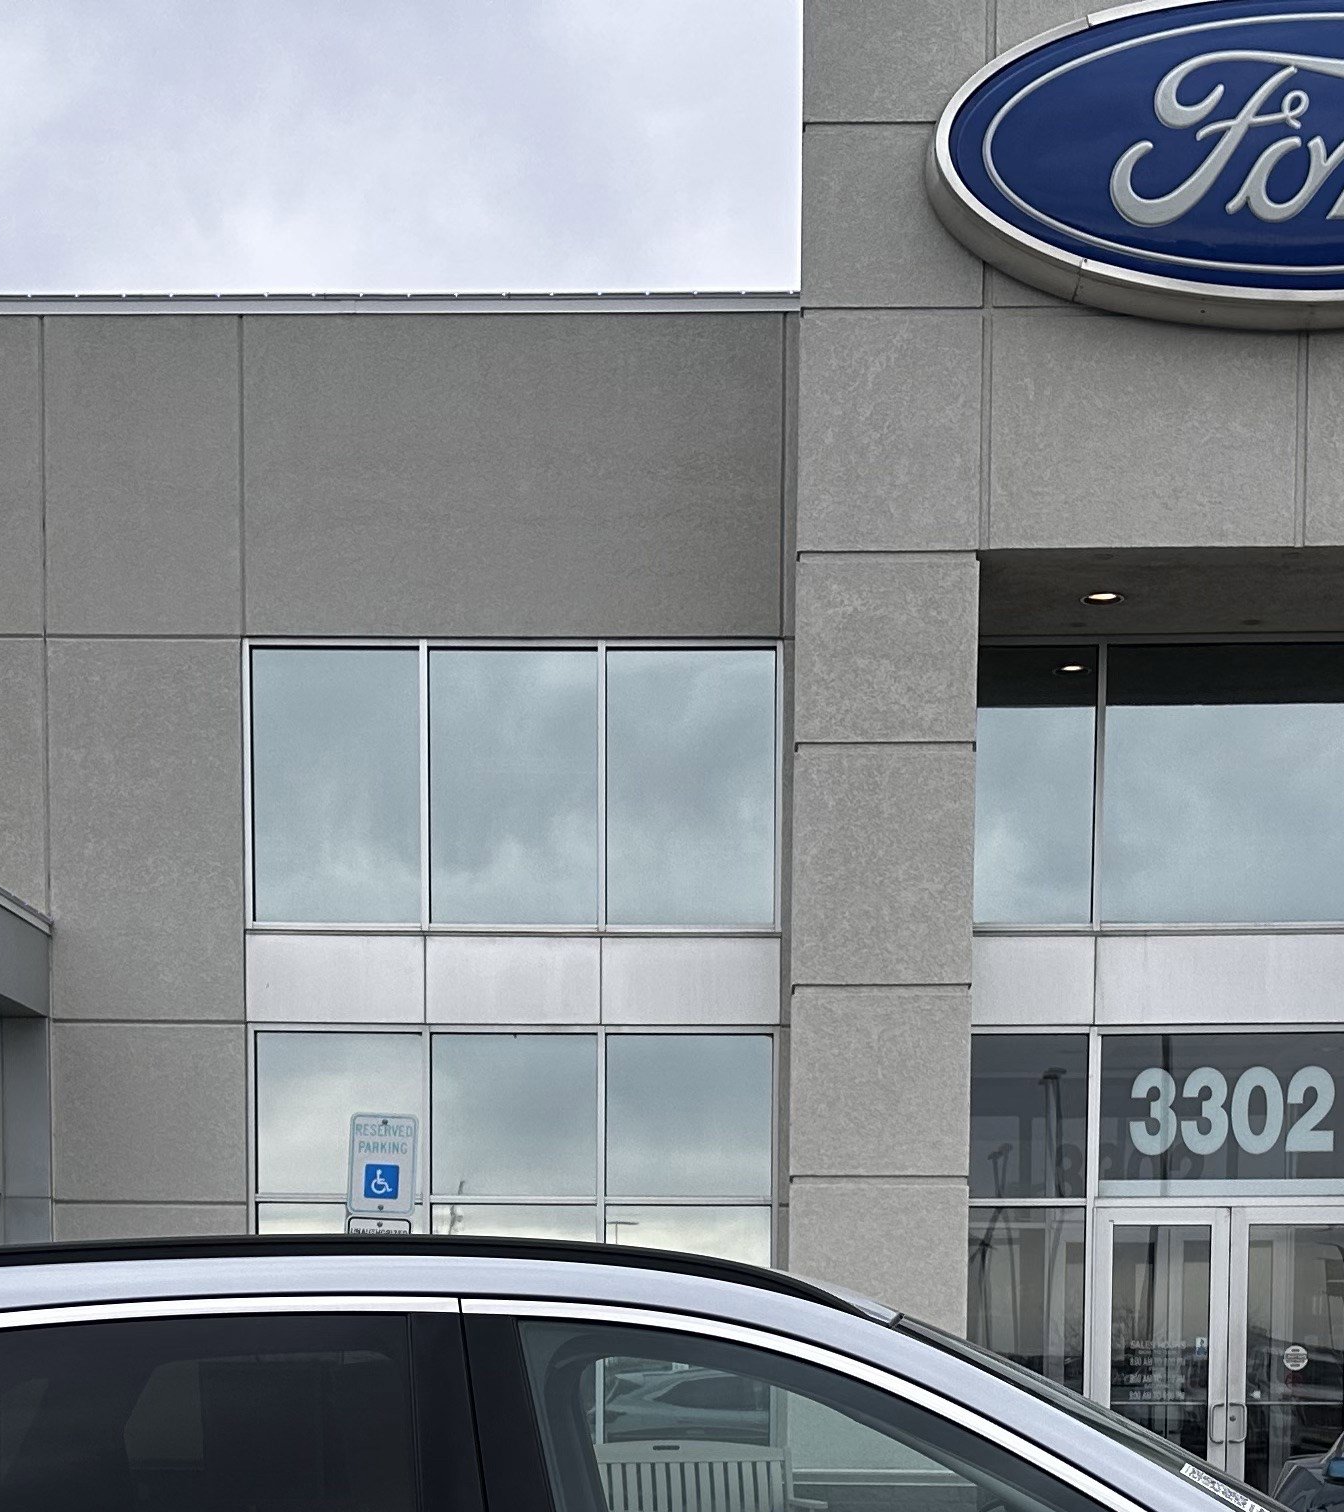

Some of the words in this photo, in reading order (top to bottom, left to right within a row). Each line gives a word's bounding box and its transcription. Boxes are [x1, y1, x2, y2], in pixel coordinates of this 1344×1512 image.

[1129, 1065, 1336, 1156] 3302
[355, 1123, 413, 1137] RESERVED
[358, 1141, 408, 1154] PARKING
